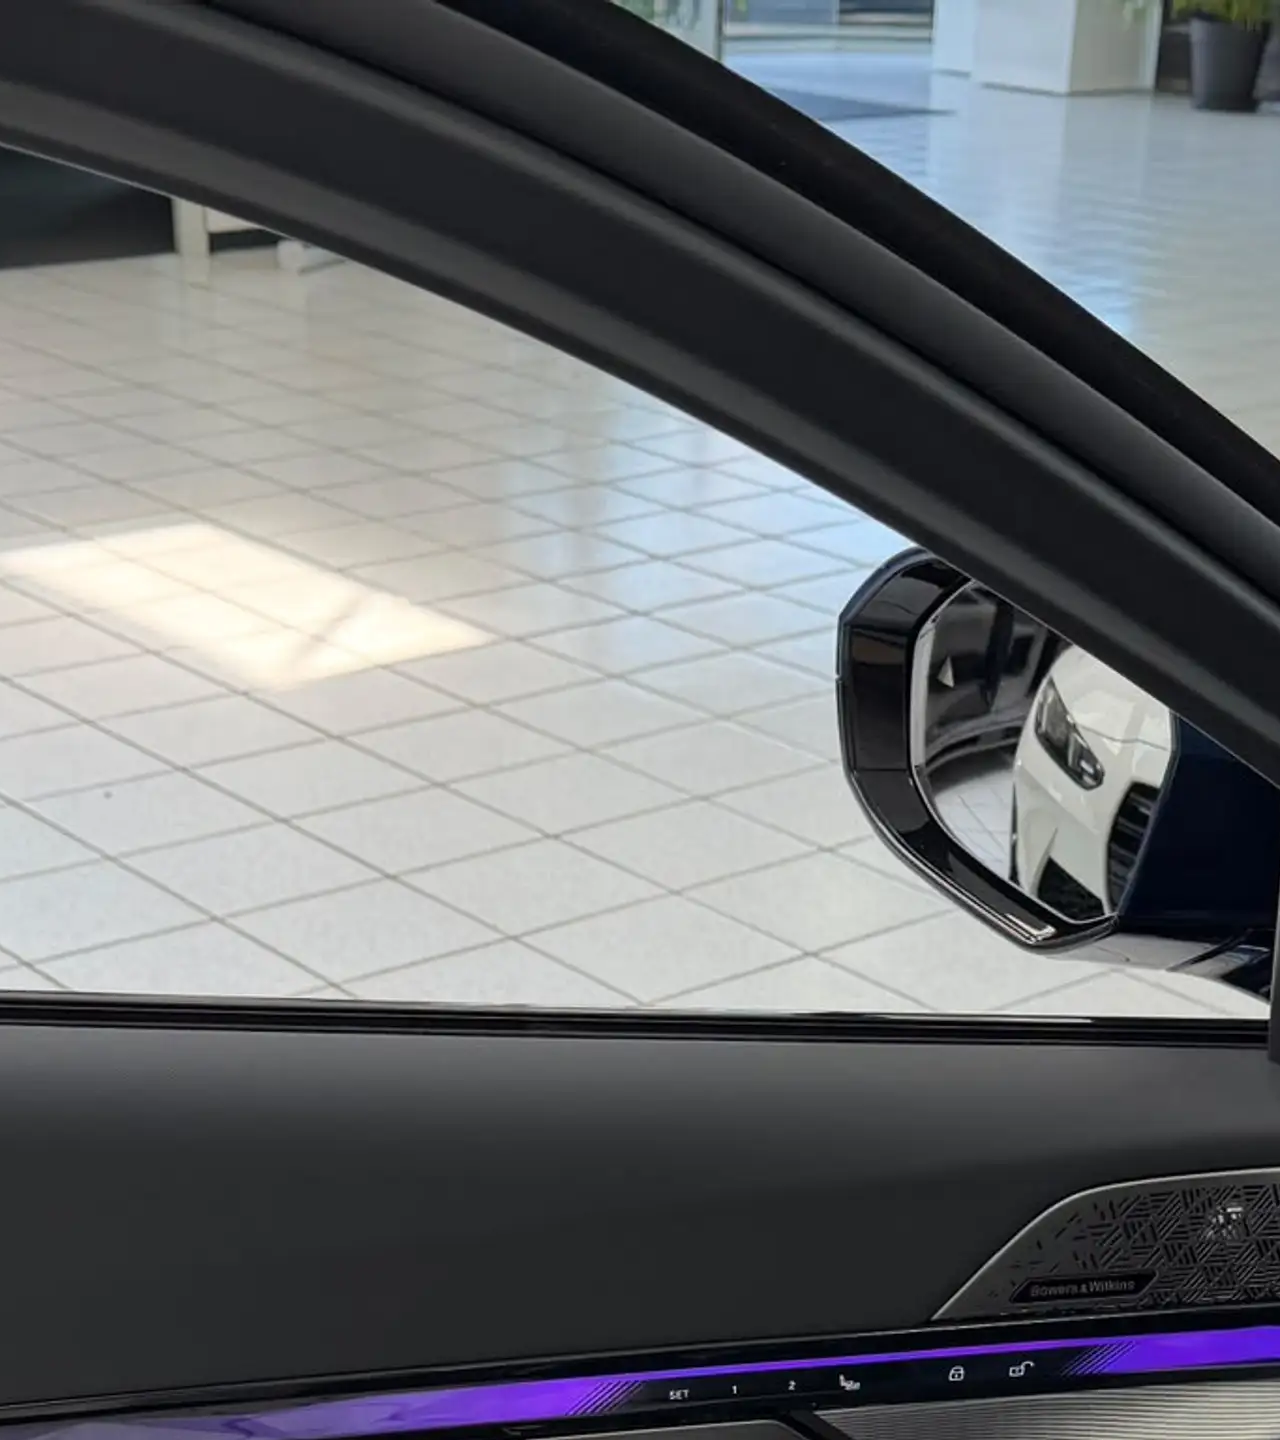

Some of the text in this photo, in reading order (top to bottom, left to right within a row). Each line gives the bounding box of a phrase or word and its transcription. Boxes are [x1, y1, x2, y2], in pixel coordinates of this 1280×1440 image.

[669, 1380, 796, 1400] SET 1 2
